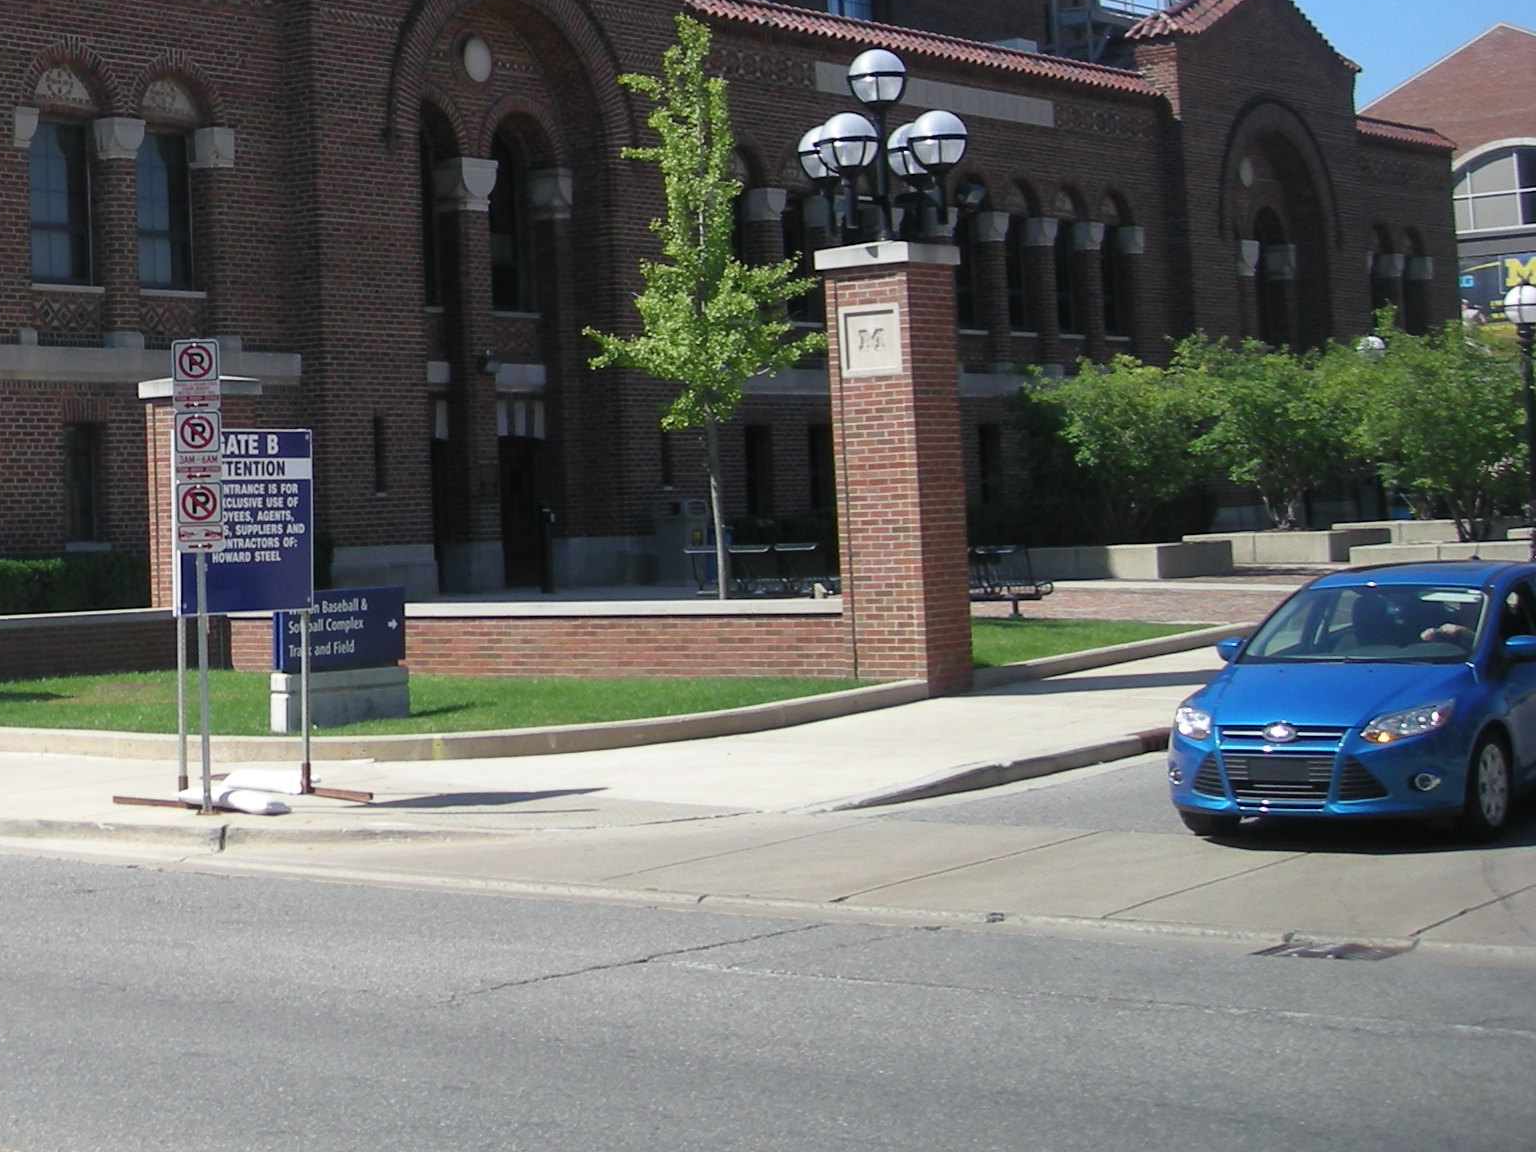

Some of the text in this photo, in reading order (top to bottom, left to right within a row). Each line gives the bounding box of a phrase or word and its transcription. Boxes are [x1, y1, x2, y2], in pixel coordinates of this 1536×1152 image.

[857, 328, 886, 352] M
[267, 434, 279, 455] B
[179, 455, 195, 464] 3AM
[222, 461, 285, 476] TENTION
[224, 483, 298, 494] NTRANCE IS FOR
[223, 497, 298, 508] XCLUSIVE USE OF
[223, 511, 294, 522] OYEES, AGENTS,
[235, 524, 283, 535] SUPPLIERS
[286, 524, 305, 534] AND
[224, 537, 298, 549] NTRACTORS OF:
[212, 551, 281, 563] HOWARD STEEL
[322, 598, 359, 613] Baseball
[360, 598, 368, 611] &
[288, 616, 364, 634] Soball Complex
[288, 639, 355, 658] Trak and Field
